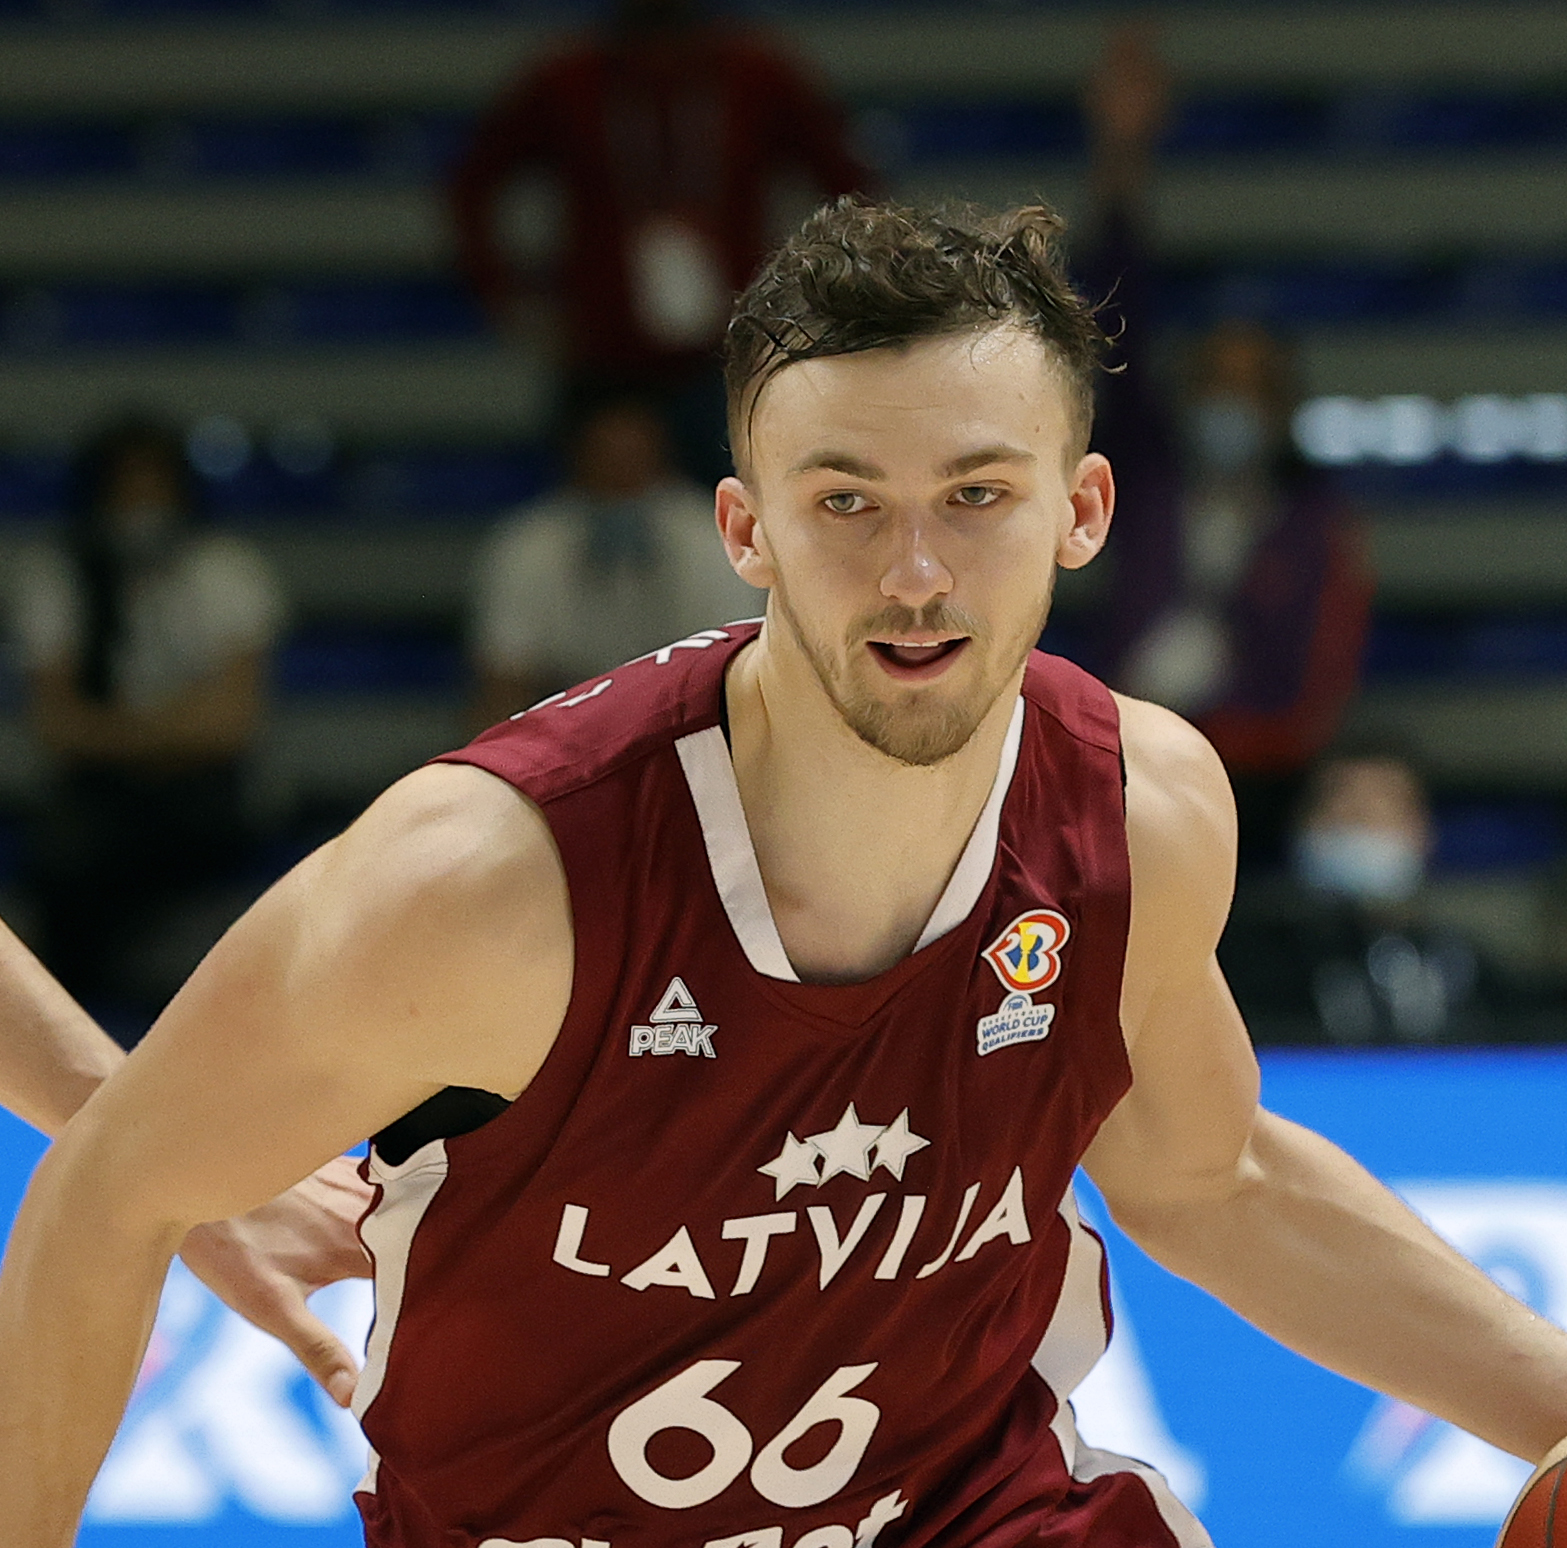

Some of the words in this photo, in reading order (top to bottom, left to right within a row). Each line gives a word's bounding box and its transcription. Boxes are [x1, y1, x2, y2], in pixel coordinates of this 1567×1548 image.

[629, 1024, 718, 1058] PEAK
[982, 1017, 1021, 1039] WORLD
[1023, 1013, 1049, 1029] CUP
[552, 1166, 1032, 1299] LATVIJA
[607, 1359, 881, 1509] 66
